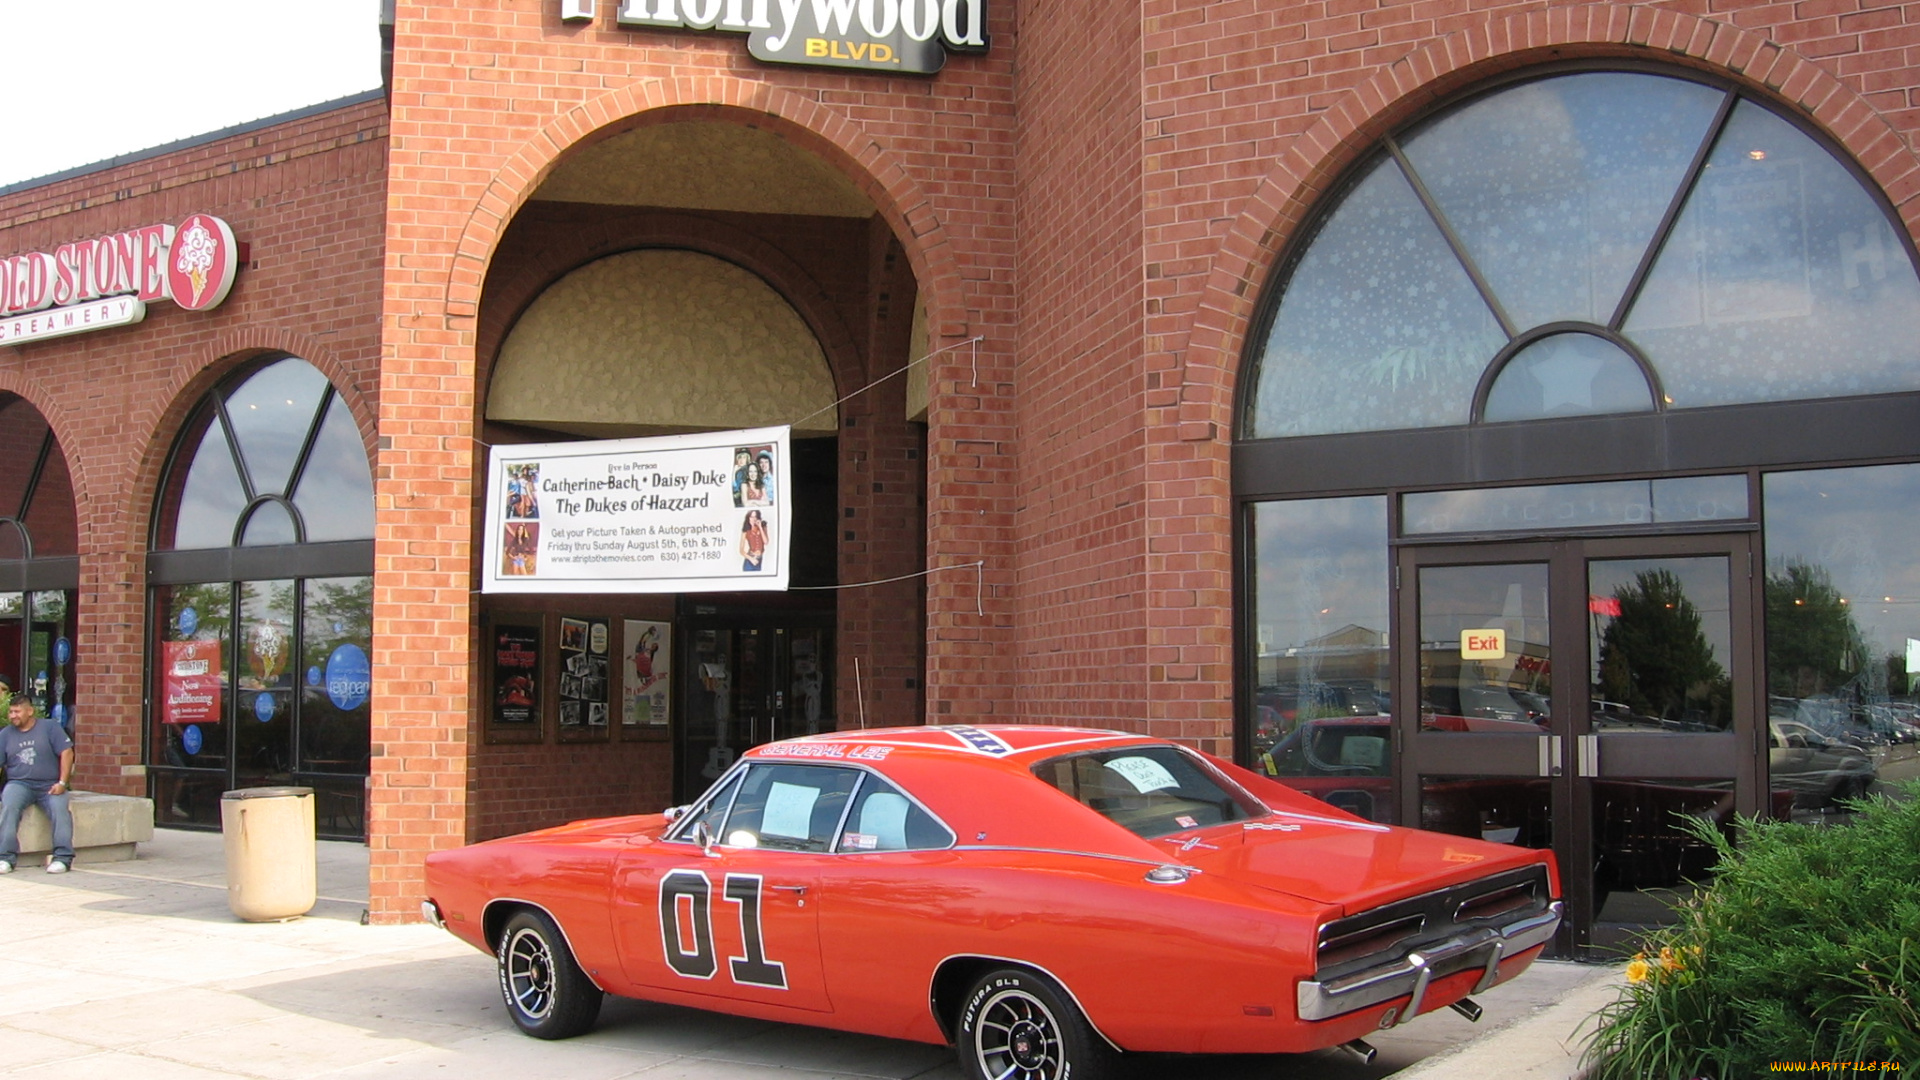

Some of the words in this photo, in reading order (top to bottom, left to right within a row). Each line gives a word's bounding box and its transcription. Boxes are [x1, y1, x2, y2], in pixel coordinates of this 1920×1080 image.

[806, 38, 901, 63] BLVD.
[53, 224, 165, 305] STONE
[0, 302, 126, 339] CREAMERY
[543, 477, 605, 495] Catherine
[608, 474, 642, 492] Bach
[652, 472, 689, 491] Daisy
[693, 469, 726, 487] Duke
[556, 498, 580, 517] The
[585, 497, 627, 515] Dukes
[631, 494, 647, 511] of
[647, 491, 709, 512] Hazzard
[551, 528, 565, 538] Get
[566, 530, 584, 540] your
[587, 527, 618, 537] Picture
[620, 525, 646, 536] Taken
[649, 525, 655, 535] &
[658, 523, 722, 537] Autographed
[547, 541, 572, 553] Friday
[574, 541, 591, 551] thru
[592, 540, 625, 552] Sunday
[626, 538, 659, 552] August
[661, 538, 680, 550] 5th,
[681, 537, 699, 548] 6th
[701, 537, 709, 547] &
[711, 536, 727, 547] 7th
[1468, 636, 1499, 651] Exit
[168, 693, 213, 706] Auditioning
[759, 744, 848, 758] GENERAL
[847, 745, 895, 761] LEE
[659, 868, 790, 990] 01
[963, 984, 992, 1032] FUTURA
